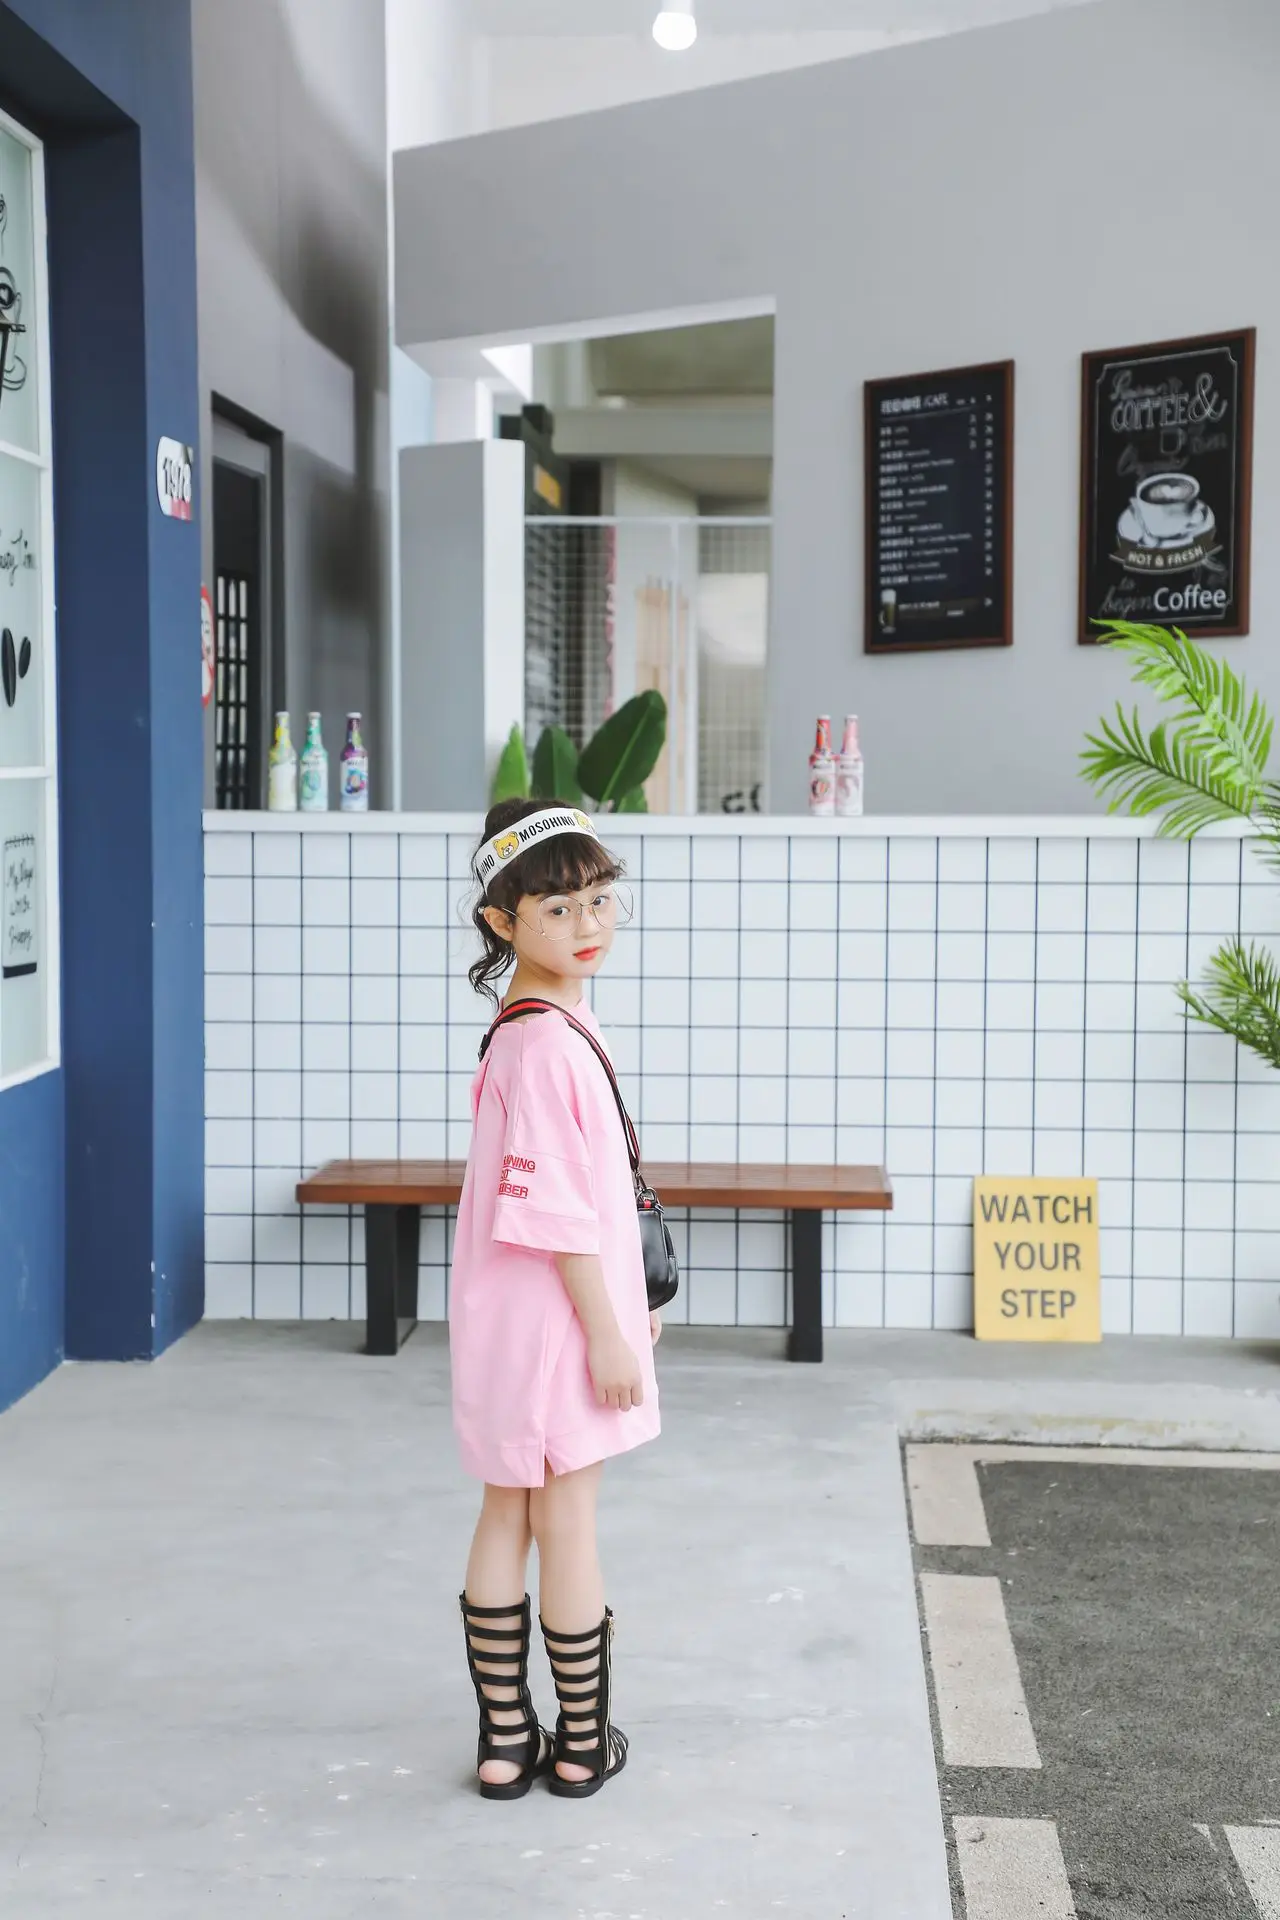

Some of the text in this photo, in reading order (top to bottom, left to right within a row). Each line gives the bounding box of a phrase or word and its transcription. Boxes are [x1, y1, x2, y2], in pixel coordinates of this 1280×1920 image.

[1153, 583, 1227, 612] Coffee
[980, 1194, 1093, 1225] WATCH
[993, 1241, 1082, 1272] YOUR
[1000, 1288, 1077, 1319] STEP
